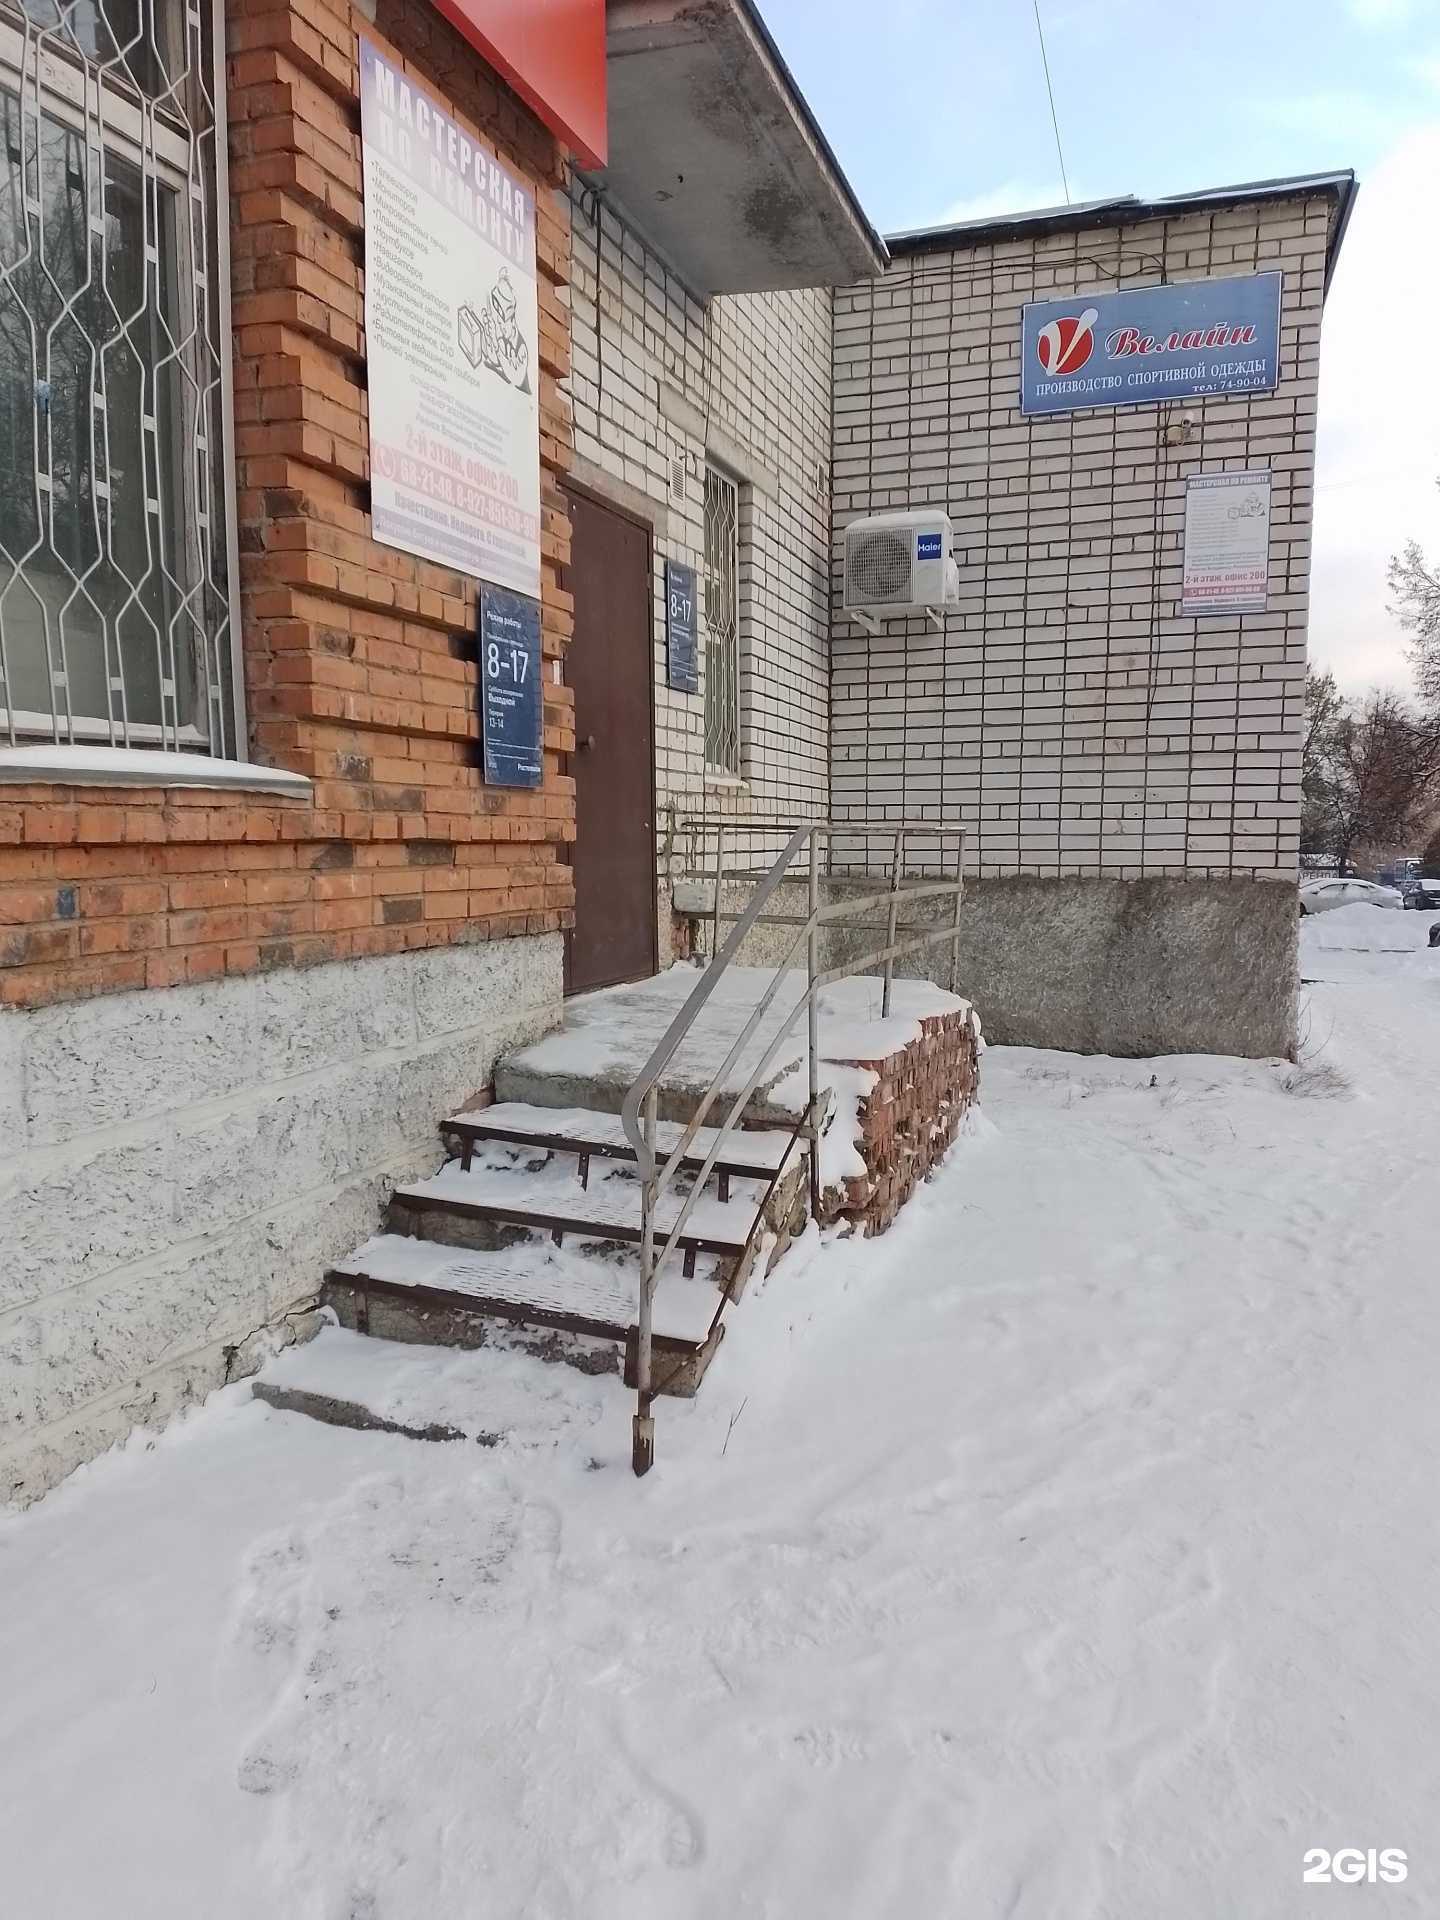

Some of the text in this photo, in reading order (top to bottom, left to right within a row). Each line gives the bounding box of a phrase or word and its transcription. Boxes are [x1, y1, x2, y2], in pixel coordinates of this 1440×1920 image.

[375, 57, 524, 227] МАСТЕРСКАЯ
[377, 106, 524, 265] ПО РЕМОНТУ
[1105, 321, 1258, 360] Велайн
[1035, 358, 1267, 397] ПРОИЗВОДСТВО СПОРТИВНОЙ ОДЕЖДЫ
[1220, 375, 1267, 389] 74-90-04
[498, 470, 518, 502] 200
[671, 594, 691, 622] 8-17
[487, 642, 529, 684] 8-17
